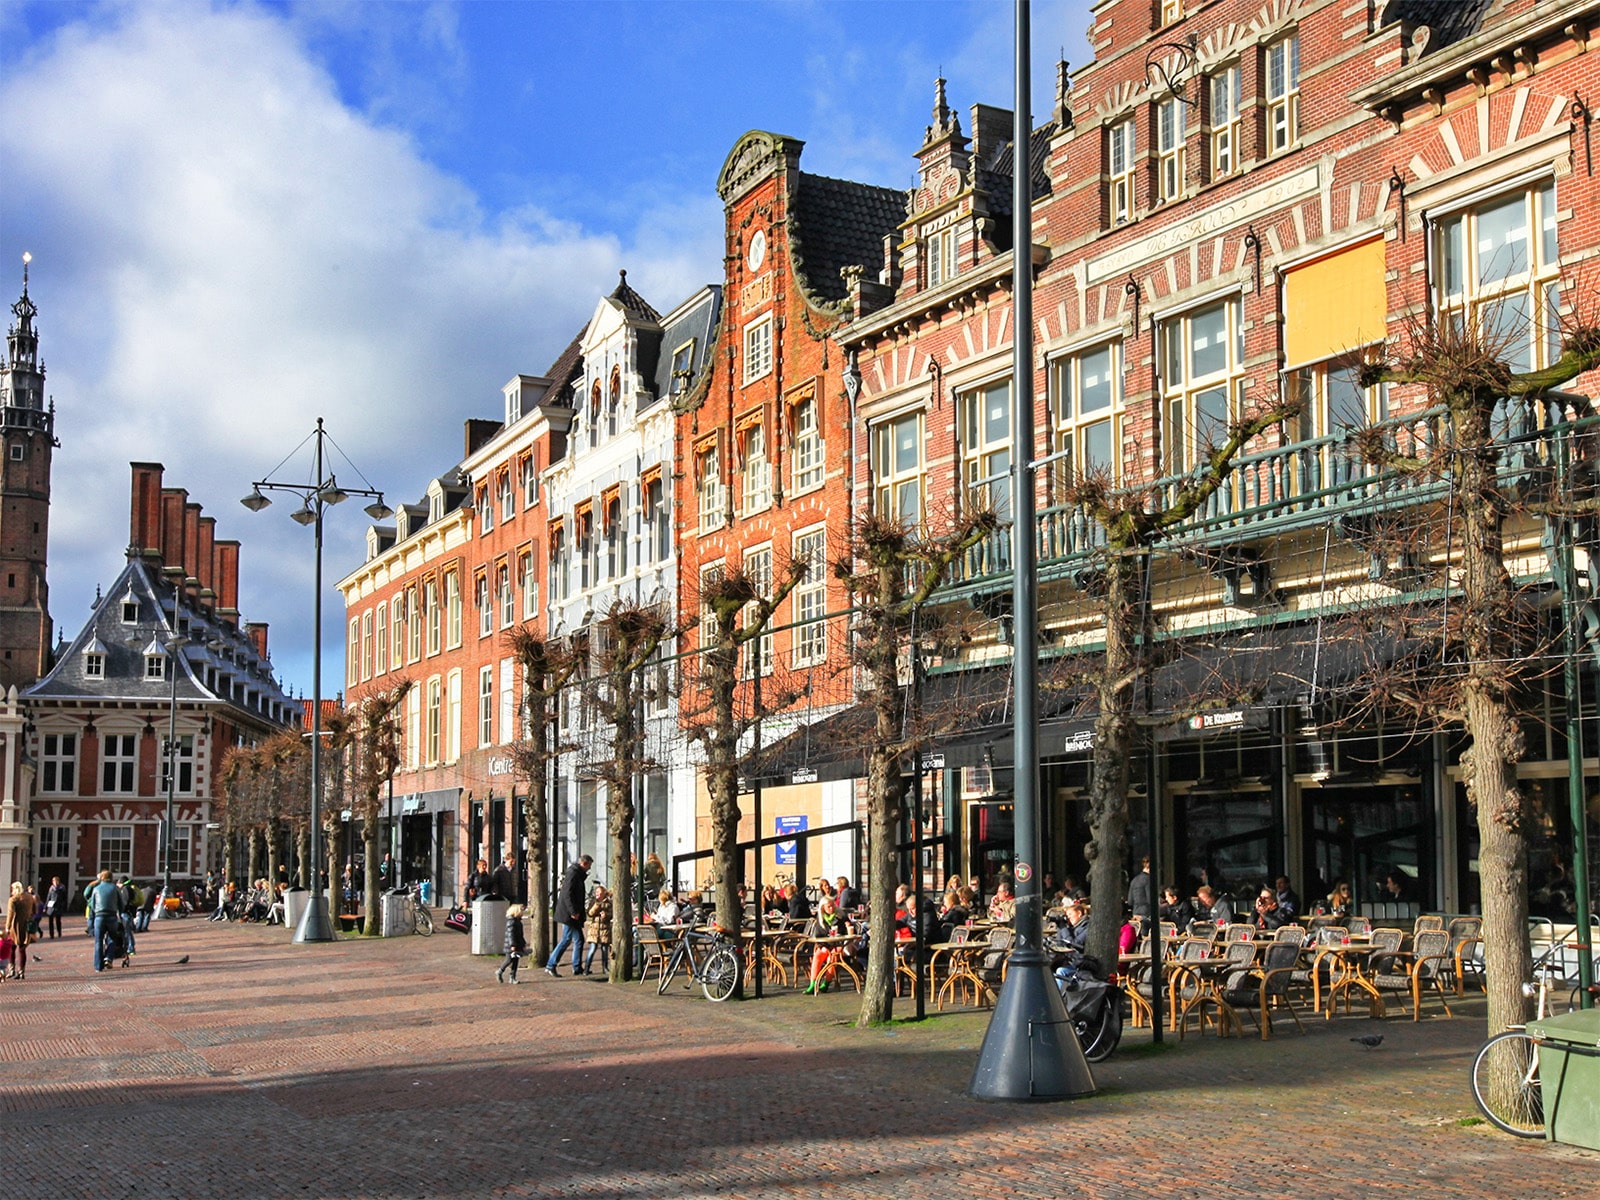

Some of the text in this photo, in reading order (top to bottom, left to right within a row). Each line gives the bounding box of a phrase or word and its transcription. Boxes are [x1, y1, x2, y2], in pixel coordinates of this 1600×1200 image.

[1146, 234, 1167, 255] DE
[1263, 177, 1306, 205] 1902
[1203, 715, 1214, 727] DE
[1213, 711, 1244, 725] KONINCK
